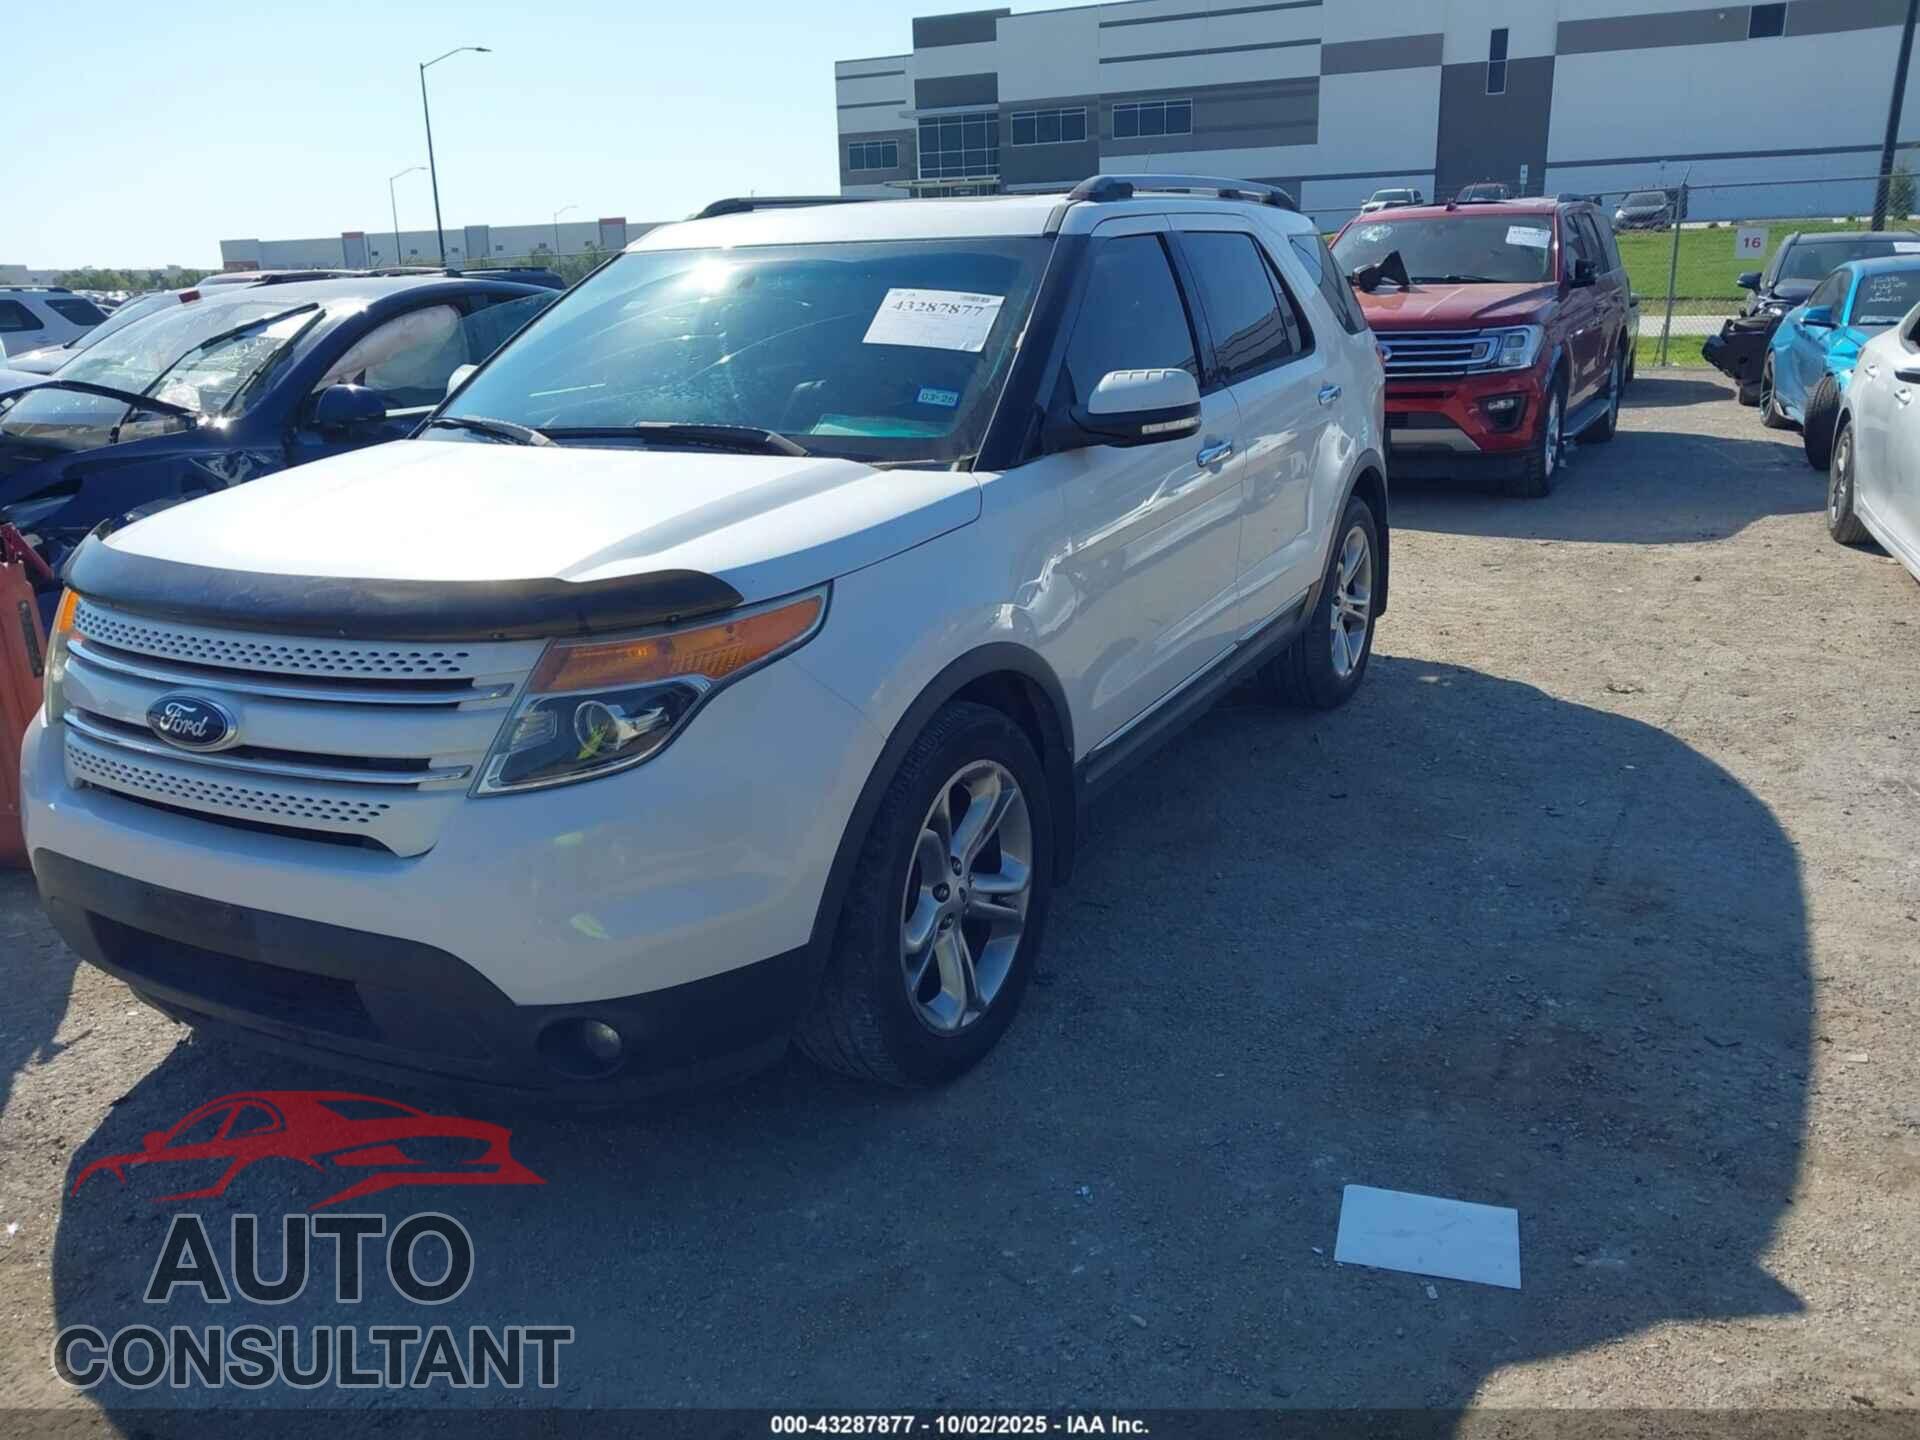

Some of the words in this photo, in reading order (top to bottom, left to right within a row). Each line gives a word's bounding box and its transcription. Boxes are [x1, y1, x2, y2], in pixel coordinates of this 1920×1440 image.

[1743, 236, 1761, 249] 16
[893, 300, 985, 316] 43287877
[160, 702, 208, 737] Ford
